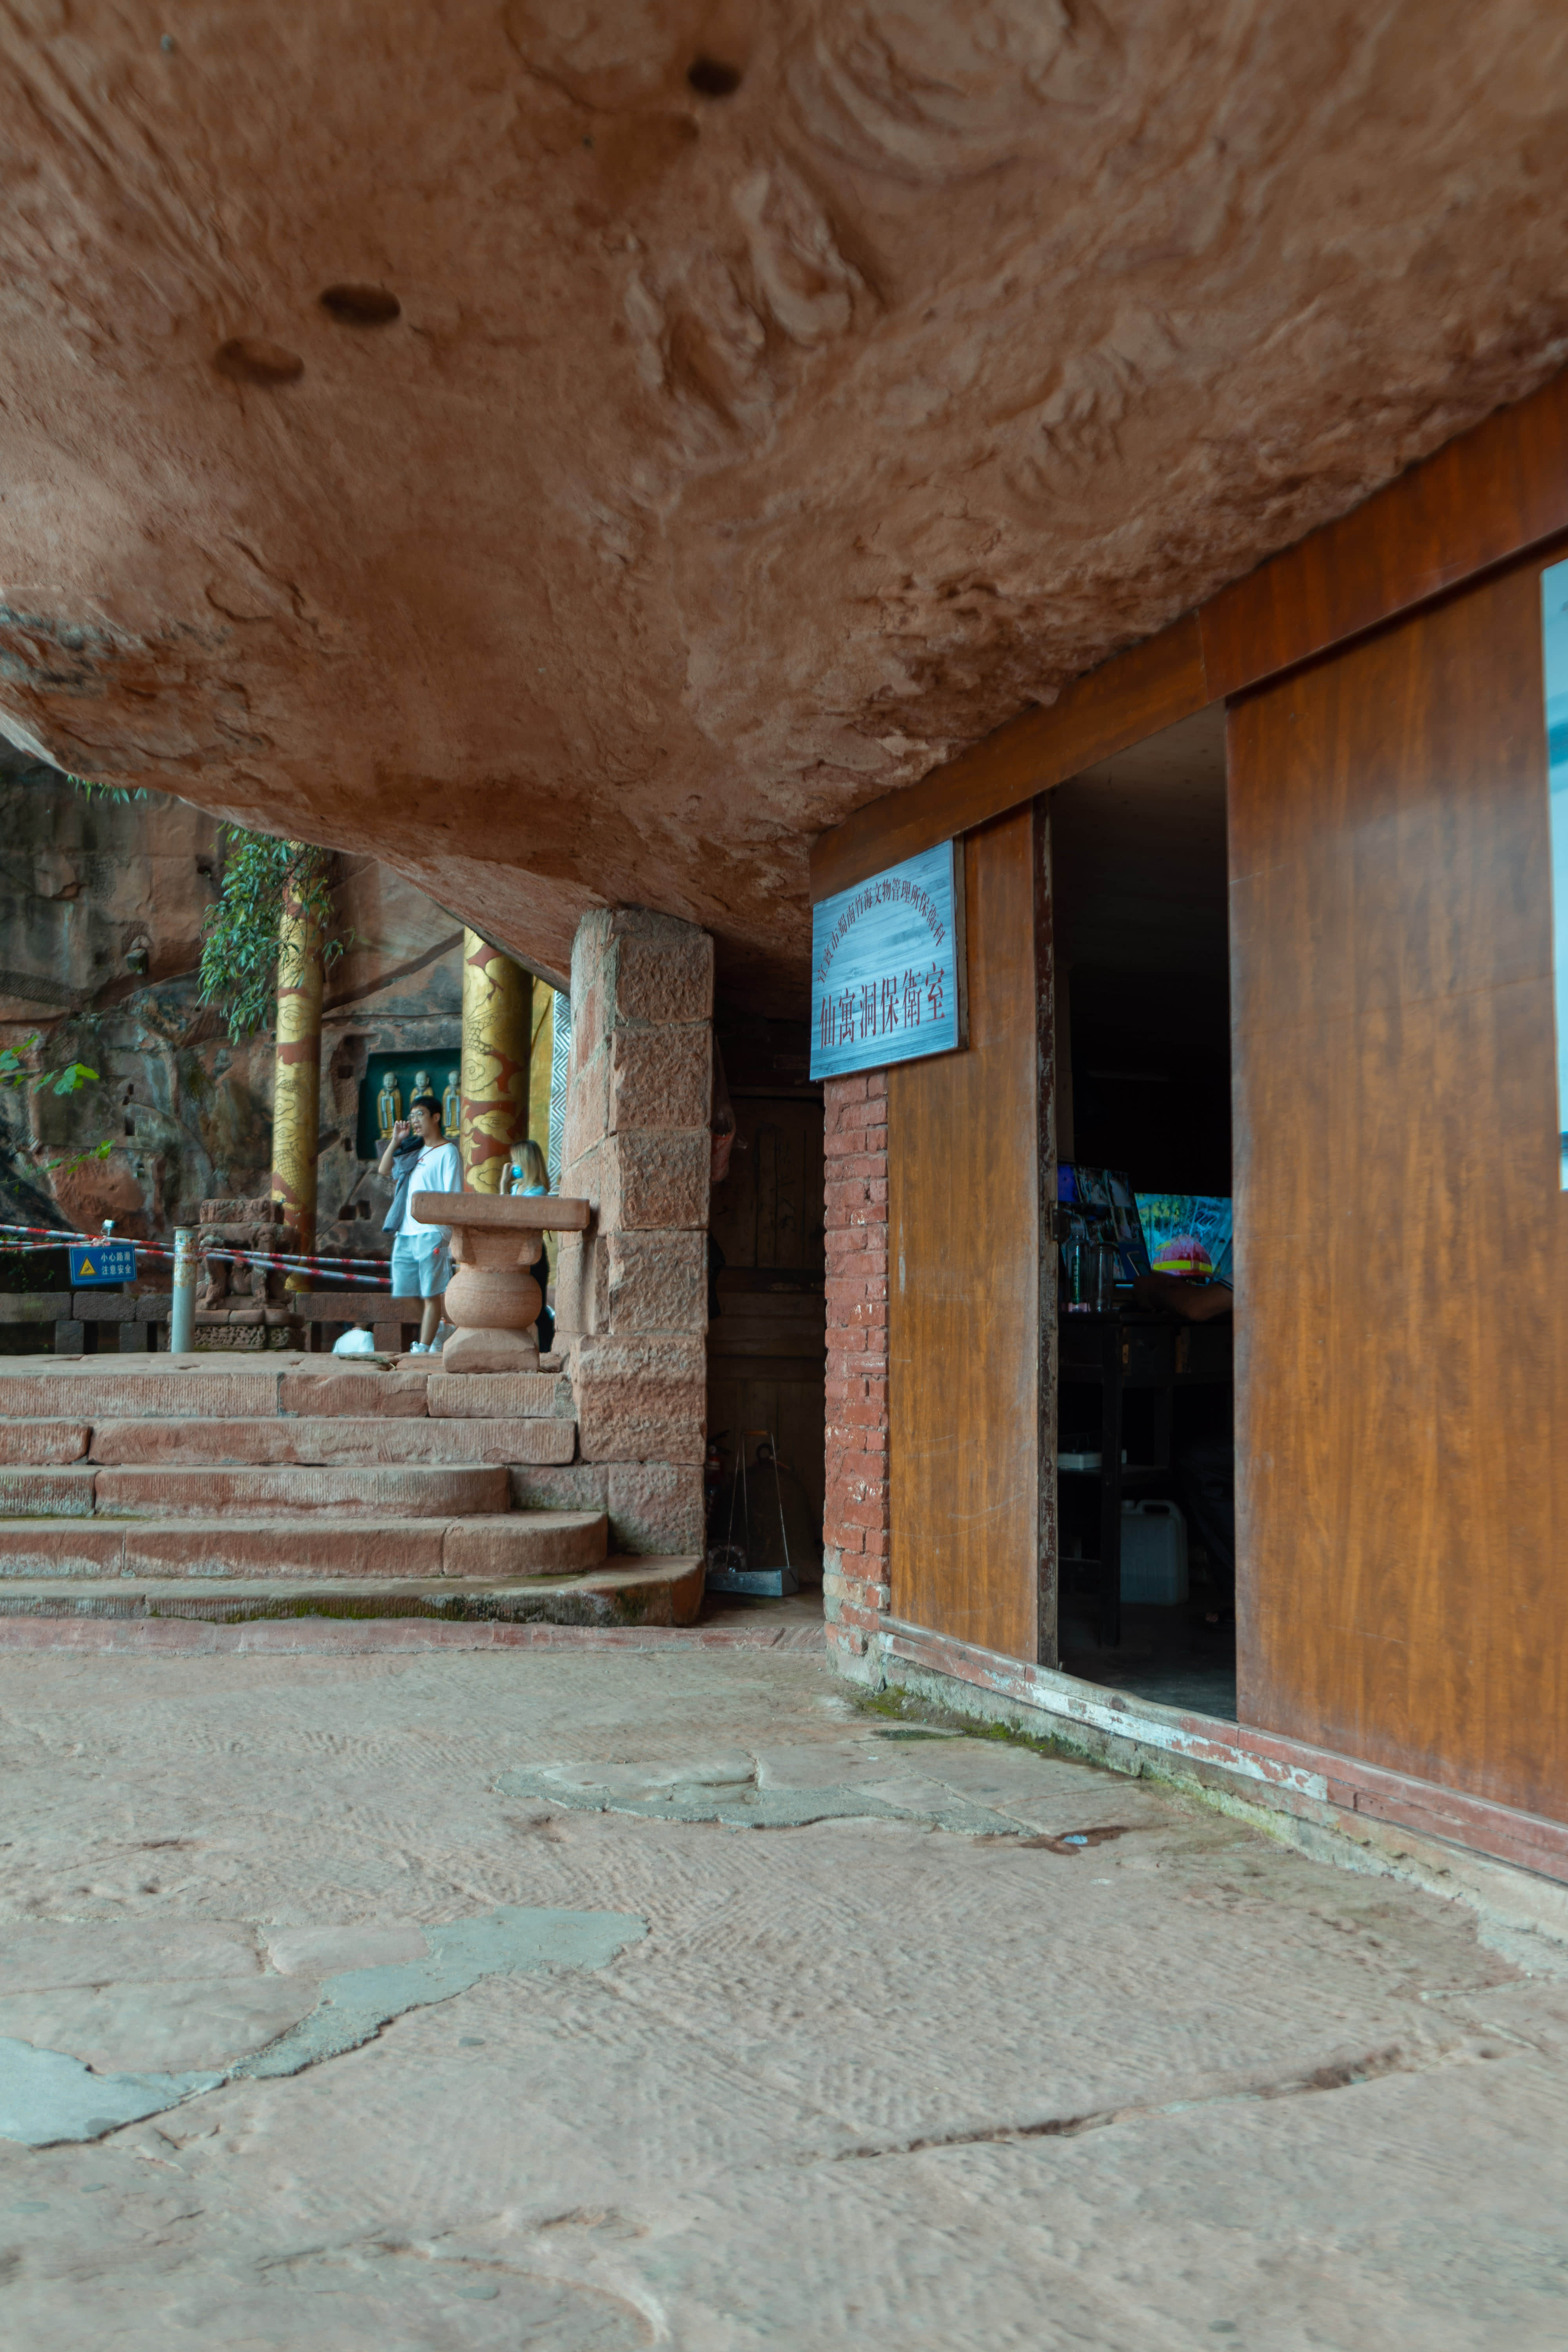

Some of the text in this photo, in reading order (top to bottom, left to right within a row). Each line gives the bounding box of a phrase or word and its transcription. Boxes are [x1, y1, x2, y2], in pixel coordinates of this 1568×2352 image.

[819, 962, 945, 1049] 仙寓洞保衛室
[101, 1251, 131, 1262] 小心路滑
[102, 1264, 131, 1274] 注意安全
